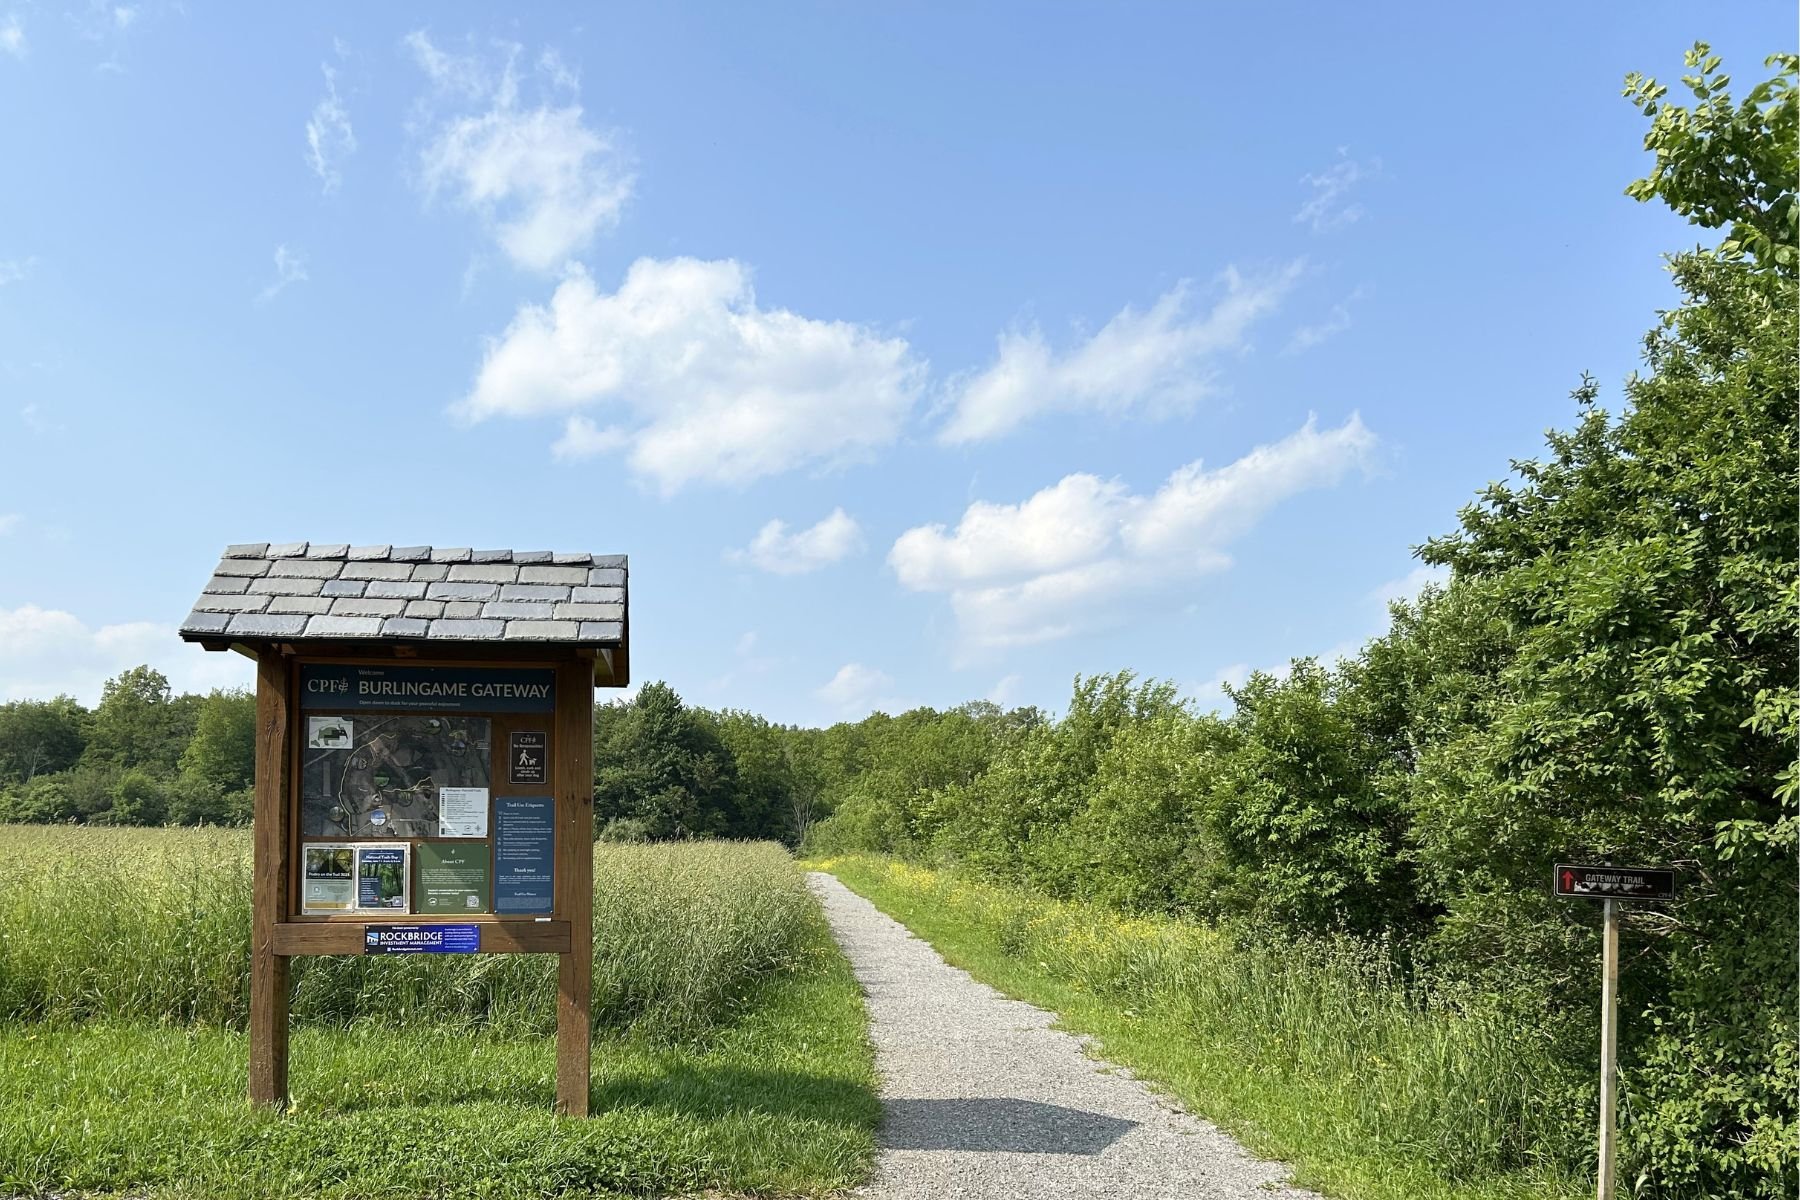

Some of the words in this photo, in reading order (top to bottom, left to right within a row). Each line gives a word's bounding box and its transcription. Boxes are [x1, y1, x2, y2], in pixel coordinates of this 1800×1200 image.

[307, 679, 340, 693] CPF
[359, 680, 467, 697] BURLINGAME
[471, 683, 550, 698] GATEWAY
[1585, 873, 1621, 883] GATEWAY
[1623, 875, 1645, 885] TRAIL
[380, 931, 443, 941] ROCKBRIDGE
